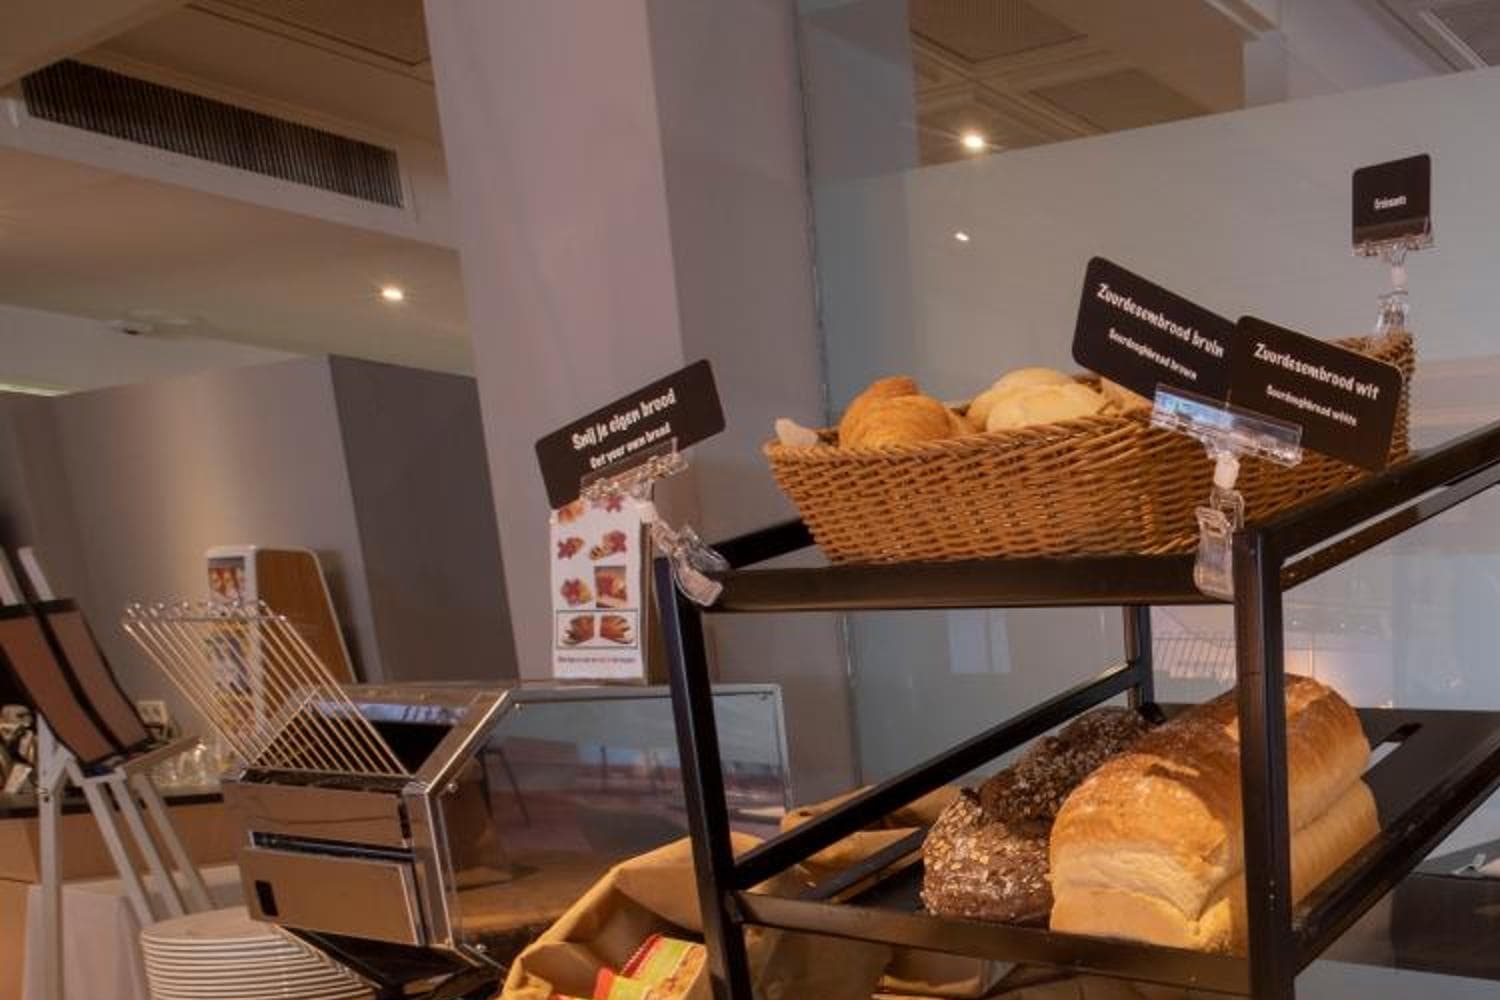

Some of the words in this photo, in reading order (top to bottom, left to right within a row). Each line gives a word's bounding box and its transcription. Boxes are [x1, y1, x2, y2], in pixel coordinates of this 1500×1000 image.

[1097, 283, 1192, 342] Zuurdesembrood
[1191, 330, 1225, 359] bruin
[1253, 343, 1355, 392] Zuurdesembrood
[1355, 381, 1380, 401] wit
[571, 426, 597, 451] Snij
[608, 408, 641, 433] eigen
[640, 387, 676, 417] brood
